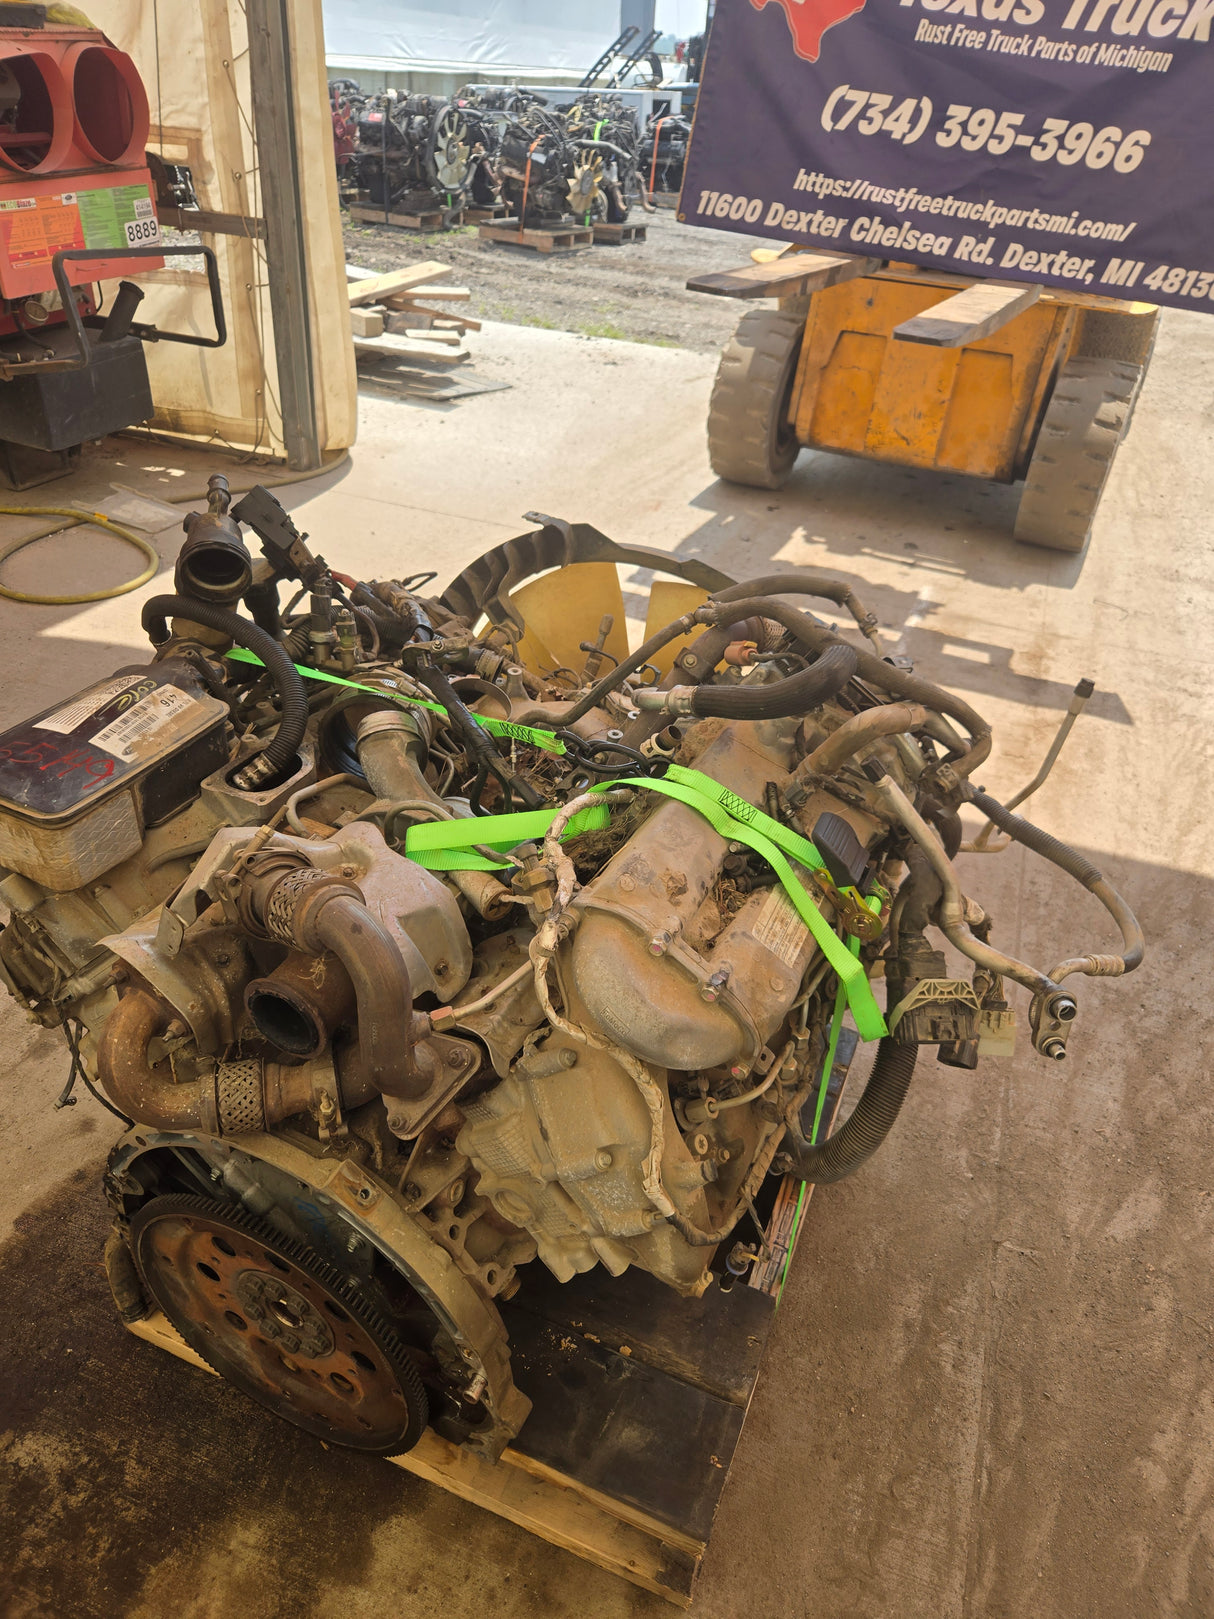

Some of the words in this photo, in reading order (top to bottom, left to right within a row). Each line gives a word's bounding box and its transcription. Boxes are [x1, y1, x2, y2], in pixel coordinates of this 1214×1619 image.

[896, 0, 1045, 25] xas
[914, 18, 952, 44] Rust
[951, 23, 985, 50] Free
[986, 29, 1033, 56] Truck
[1030, 36, 1077, 62] Parts
[1076, 42, 1099, 65] of
[1094, 45, 1174, 73] Michigan
[821, 84, 933, 144] (734)
[935, 104, 1151, 173] 395-3966
[127, 220, 157, 242] 8889
[793, 168, 1137, 242] https://rustfreetruckpartsmi.com/
[696, 190, 764, 223] 11600
[763, 202, 849, 239] Dexter
[849, 216, 953, 257] Chelsea
[952, 235, 996, 265] Rd.
[999, 242, 1096, 285] Dexter,
[1100, 258, 1146, 288] MI
